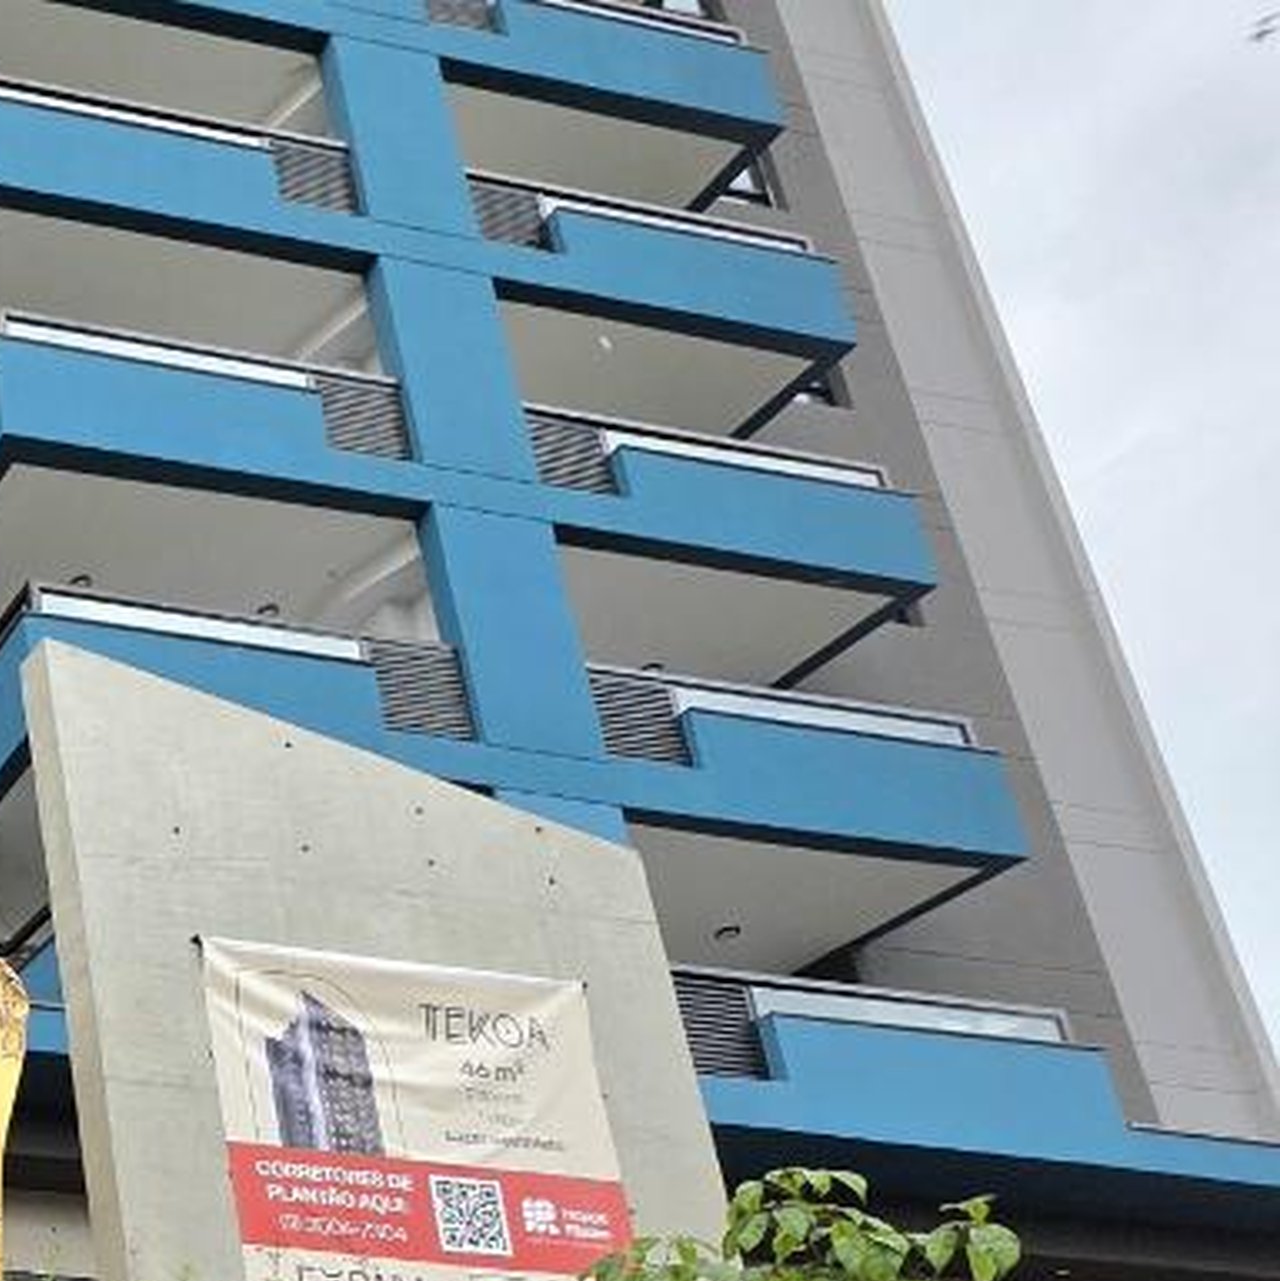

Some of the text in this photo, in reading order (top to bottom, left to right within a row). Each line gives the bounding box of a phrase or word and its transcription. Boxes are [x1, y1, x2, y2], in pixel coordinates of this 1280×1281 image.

[255, 1160, 414, 1192] CORRETORES DE
[267, 1183, 355, 1209] PLANTÃO
